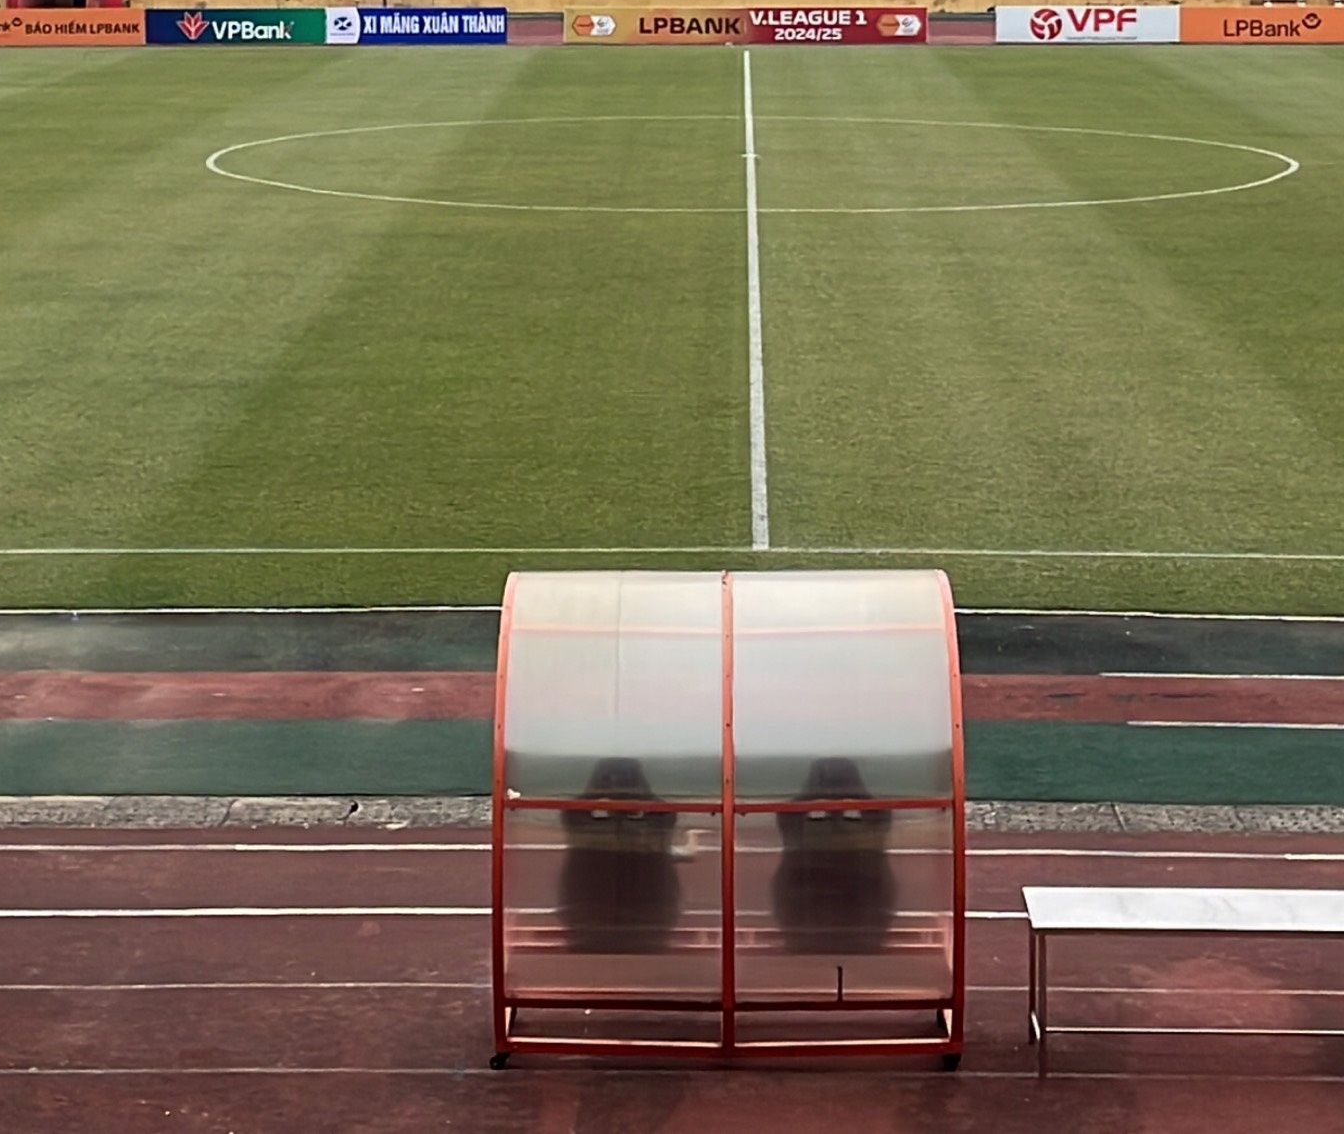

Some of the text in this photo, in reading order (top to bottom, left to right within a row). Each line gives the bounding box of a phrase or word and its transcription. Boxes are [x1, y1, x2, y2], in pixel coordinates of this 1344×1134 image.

[363, 16, 377, 33] XI
[639, 17, 741, 34] LPBANK
[749, 10, 867, 25] V.LEAGUE 1
[1067, 8, 1138, 32] VPF
[89, 23, 140, 34] LPBANK
[212, 21, 291, 39] VPBank
[774, 28, 842, 40] 2024/25
[1223, 19, 1300, 37] LPBank
